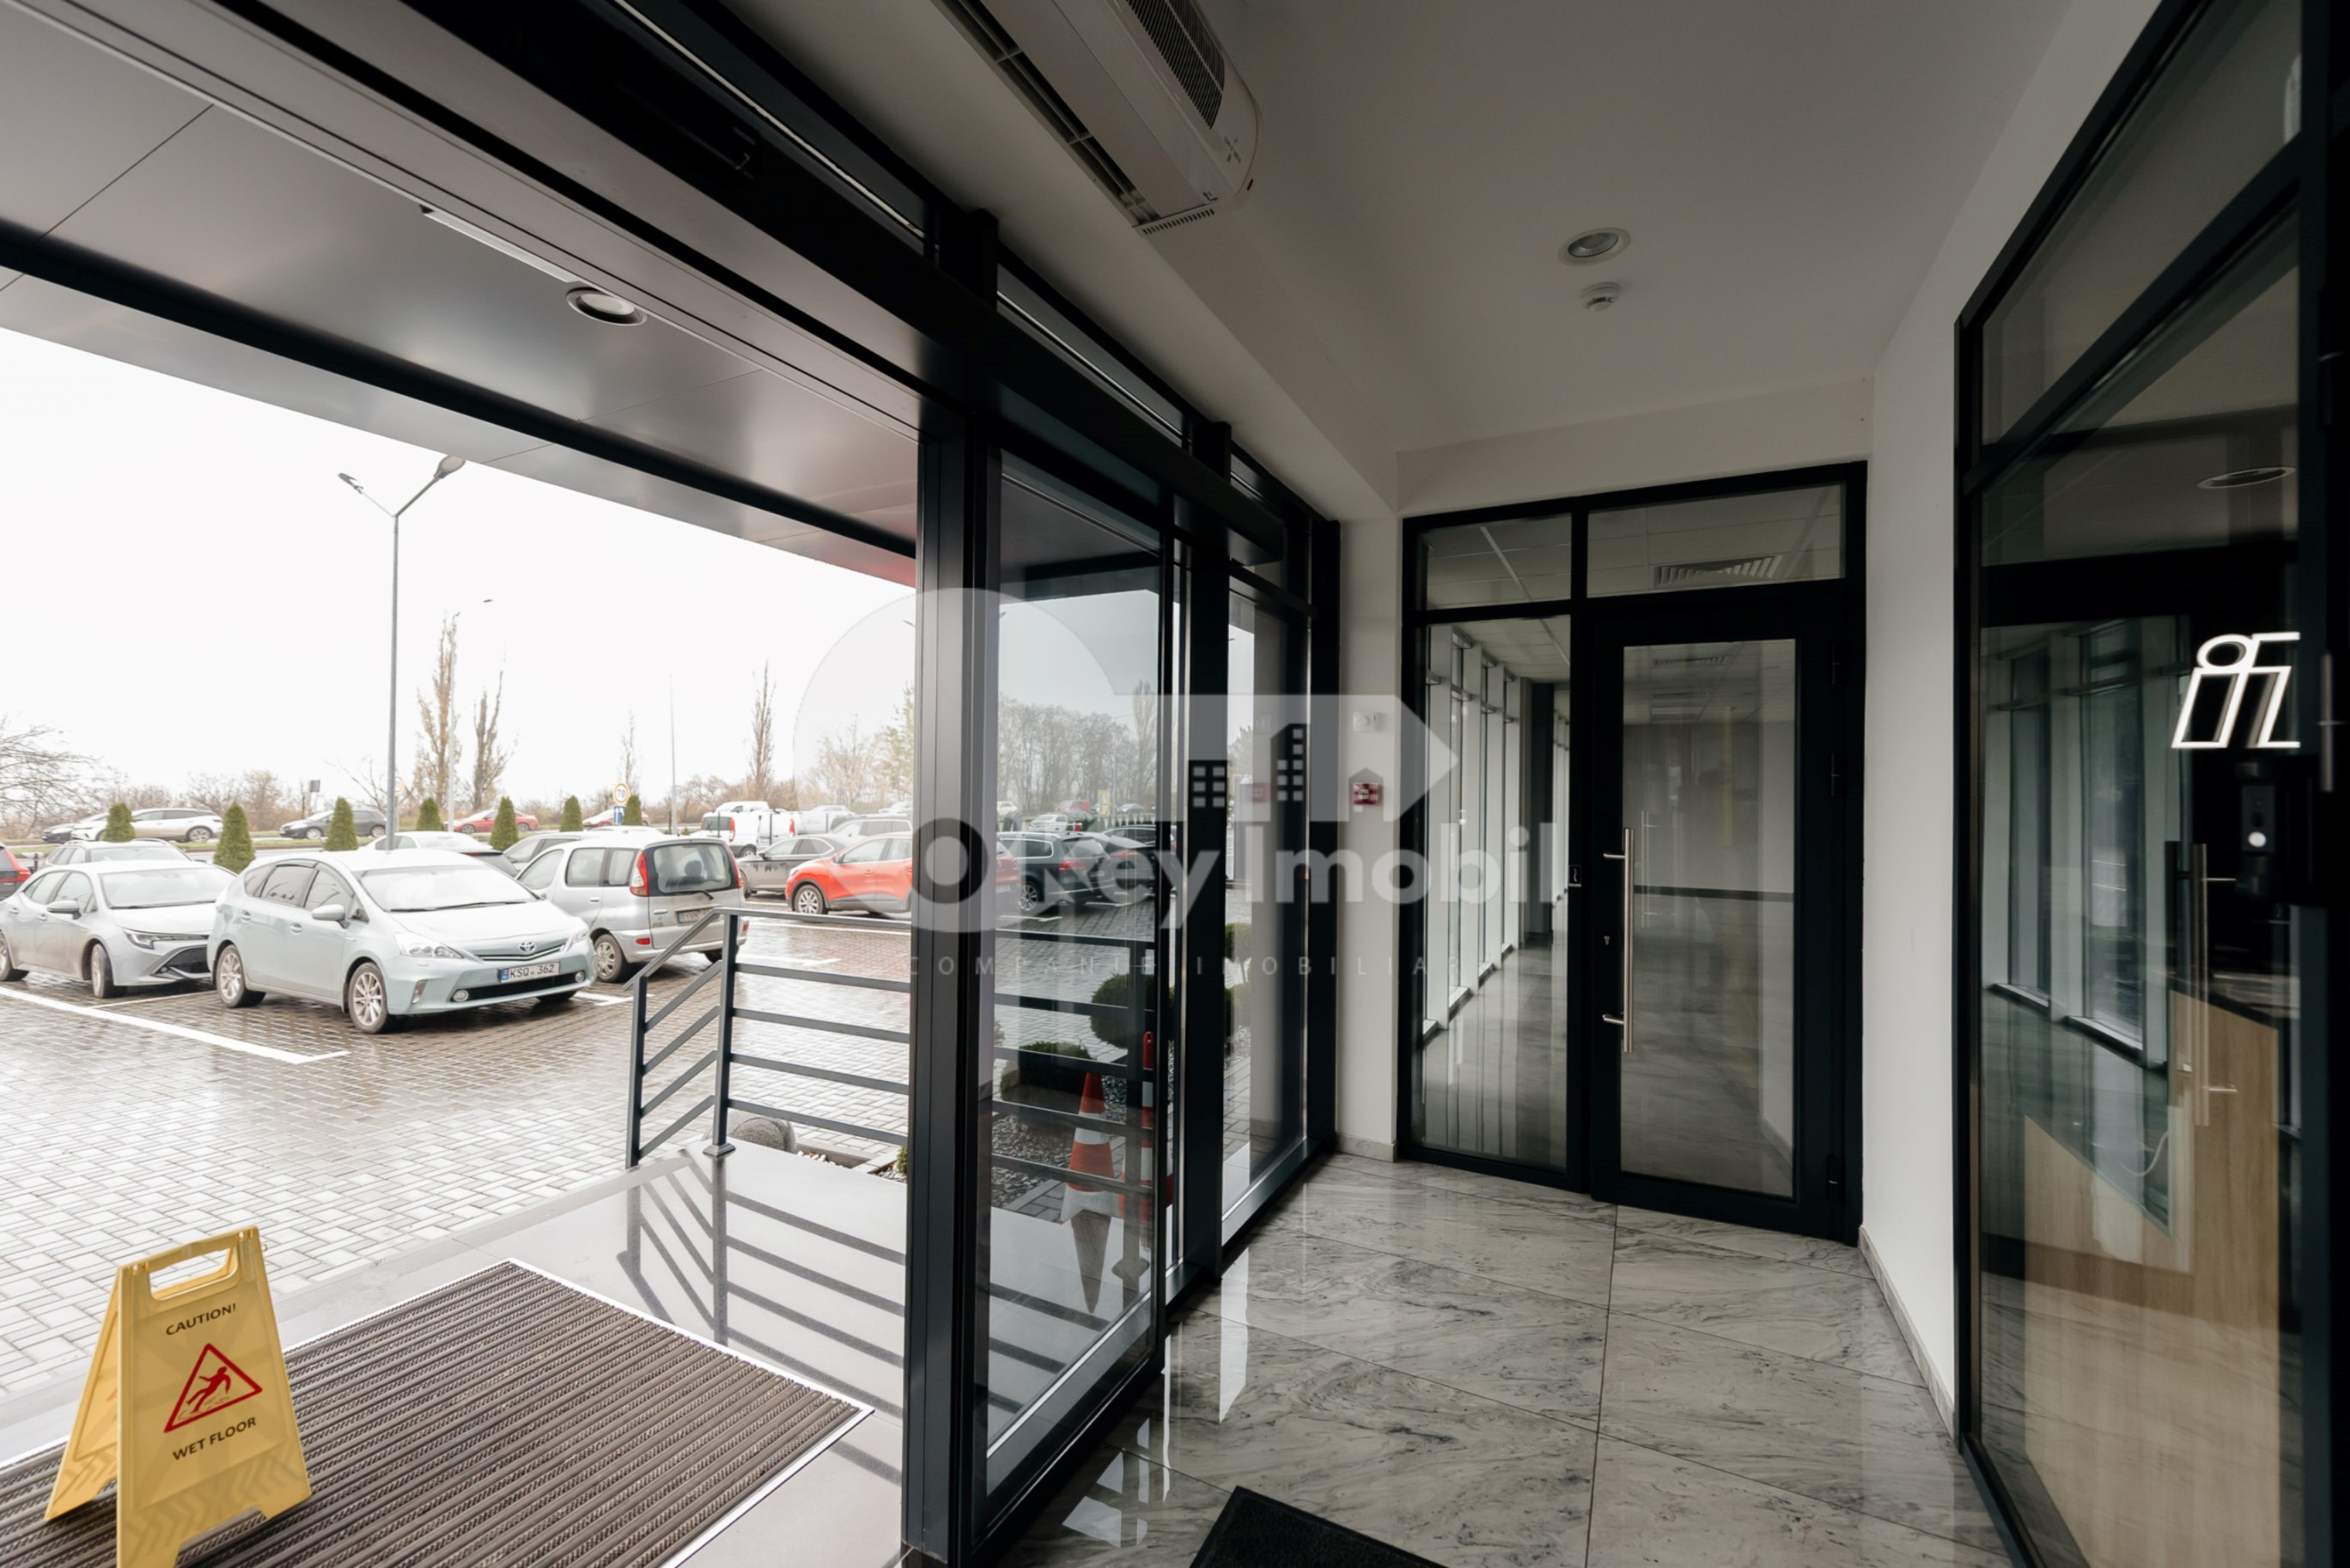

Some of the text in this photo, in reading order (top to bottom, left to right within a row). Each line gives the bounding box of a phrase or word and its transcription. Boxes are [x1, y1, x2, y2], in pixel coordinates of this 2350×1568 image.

[618, 788, 626, 799] 70
[537, 963, 555, 975] 362
[165, 1303, 236, 1336] CAUTION!
[173, 1417, 257, 1461] WET FLOOR
